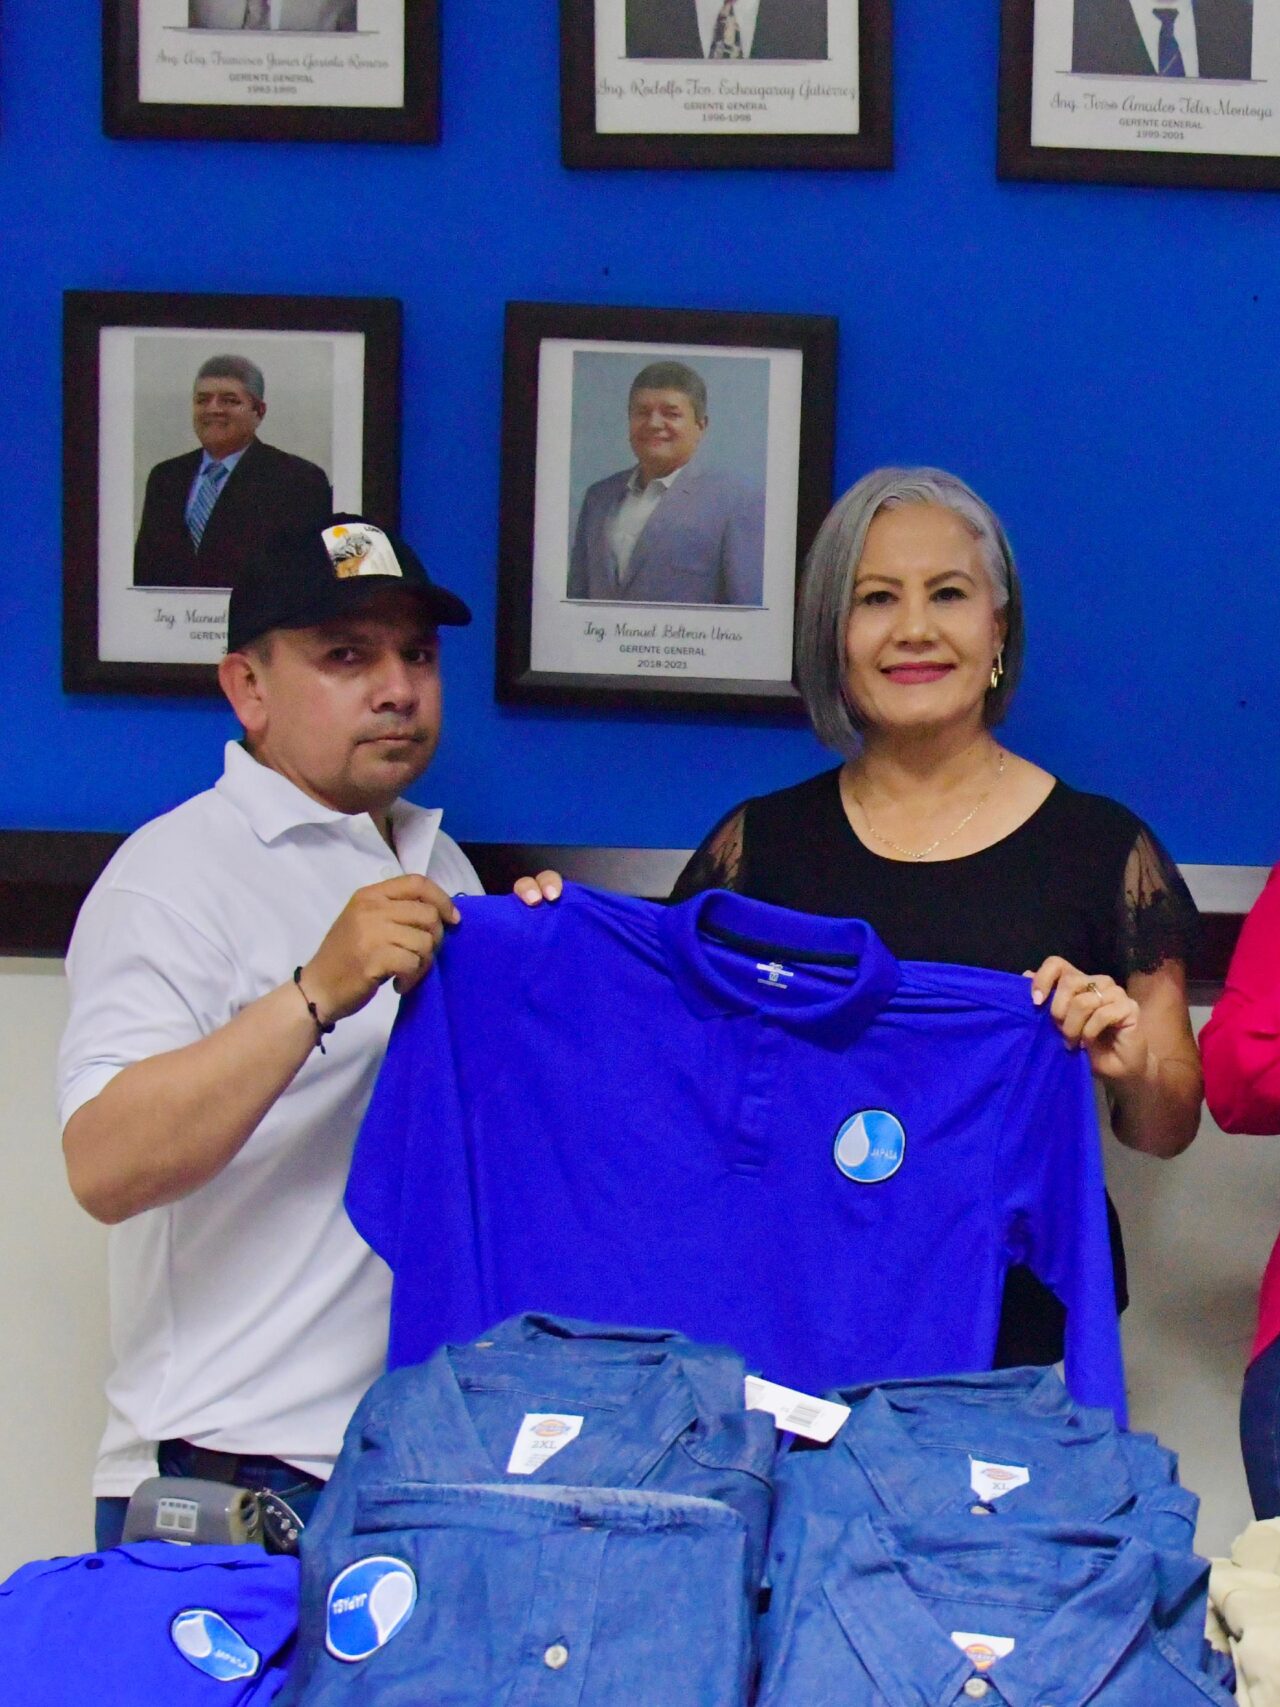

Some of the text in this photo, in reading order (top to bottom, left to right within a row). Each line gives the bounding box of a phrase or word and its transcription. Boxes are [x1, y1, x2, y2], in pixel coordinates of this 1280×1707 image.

[229, 73, 313, 83] GERENTE GENERAL
[631, 79, 682, 98] Rodolfo
[684, 102, 767, 111] GERENTE GENERAL
[1213, 98, 1273, 121] Montoya
[1118, 118, 1203, 129] GERENTE GENERAL
[184, 608, 227, 624] Manuel
[190, 631, 228, 640] GERENT
[614, 623, 656, 639] Manuel
[619, 644, 706, 656] GERENTE GENERAL
[531, 1440, 557, 1449] 2XL
